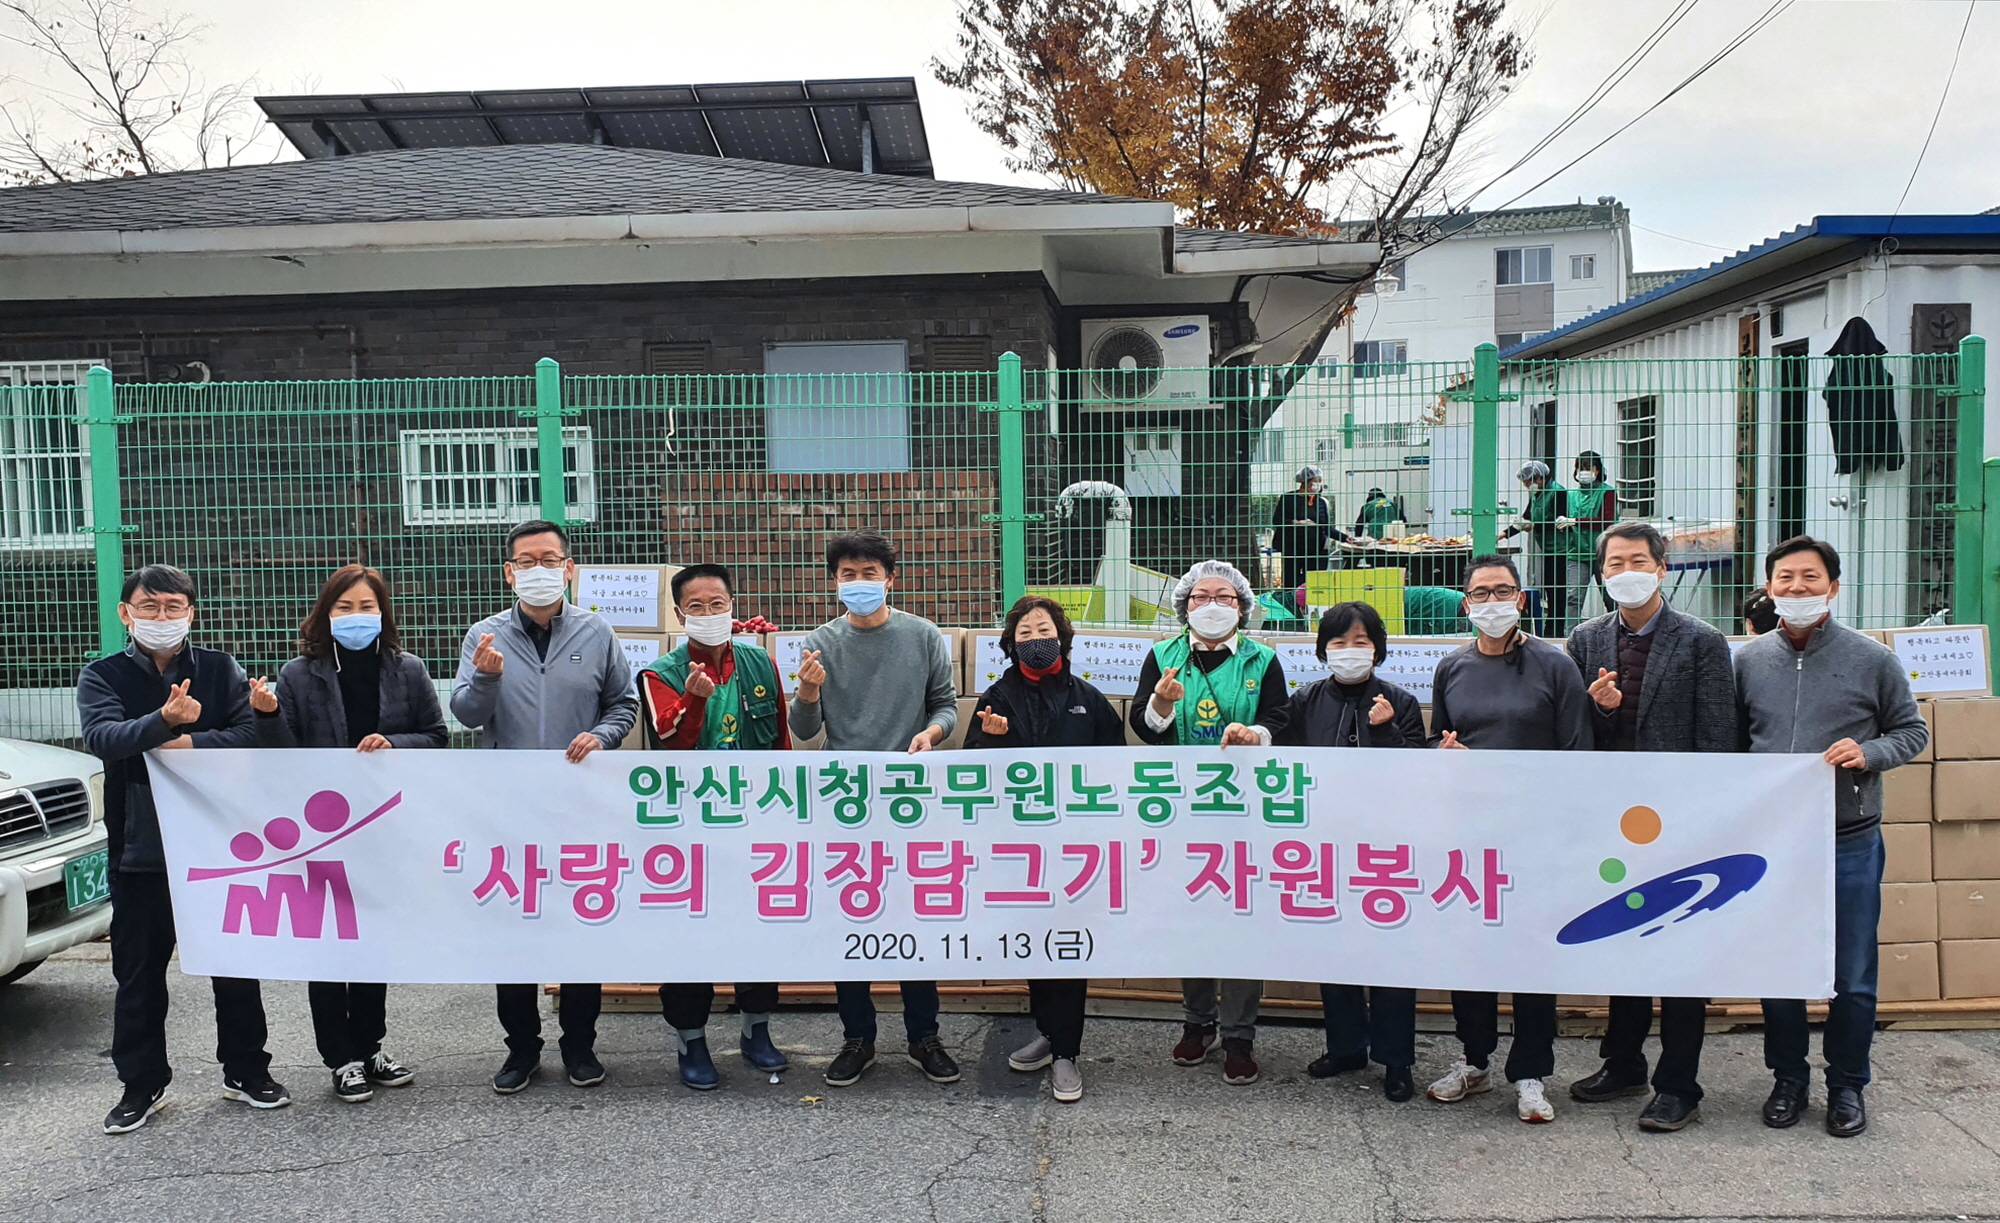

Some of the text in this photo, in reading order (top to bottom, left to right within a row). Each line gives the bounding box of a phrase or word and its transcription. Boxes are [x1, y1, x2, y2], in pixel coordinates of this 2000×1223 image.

[1167, 327, 1196, 335] SAMSUNG
[628, 757, 1314, 826] 안산시청공무원노동조합
[1185, 839, 1509, 924] 자원봉사
[844, 932, 924, 961] 2020.
[941, 932, 983, 961] 11.
[1044, 928, 1095, 962] (금)
